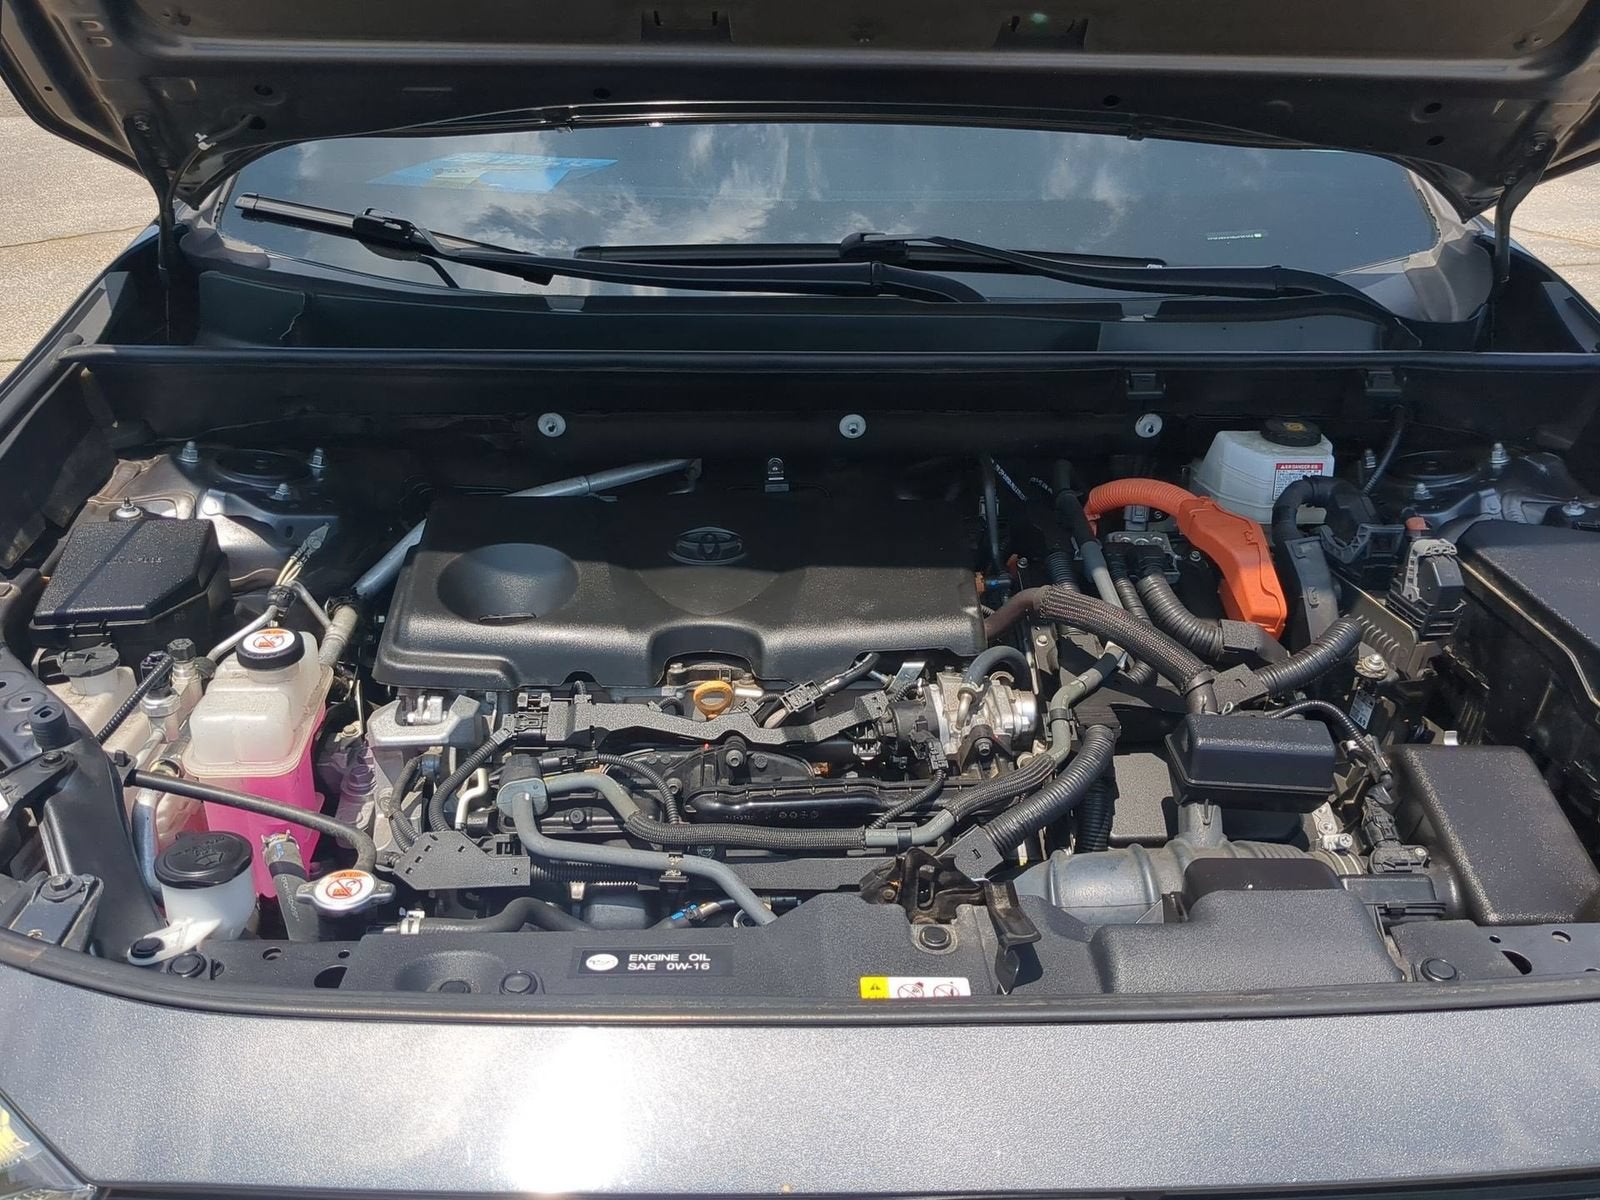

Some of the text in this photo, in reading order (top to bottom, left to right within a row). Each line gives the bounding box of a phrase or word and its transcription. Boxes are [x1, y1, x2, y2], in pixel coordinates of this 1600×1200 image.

[628, 953, 711, 962] ENGINE OIL
[627, 962, 710, 971] SAE 0W-16
